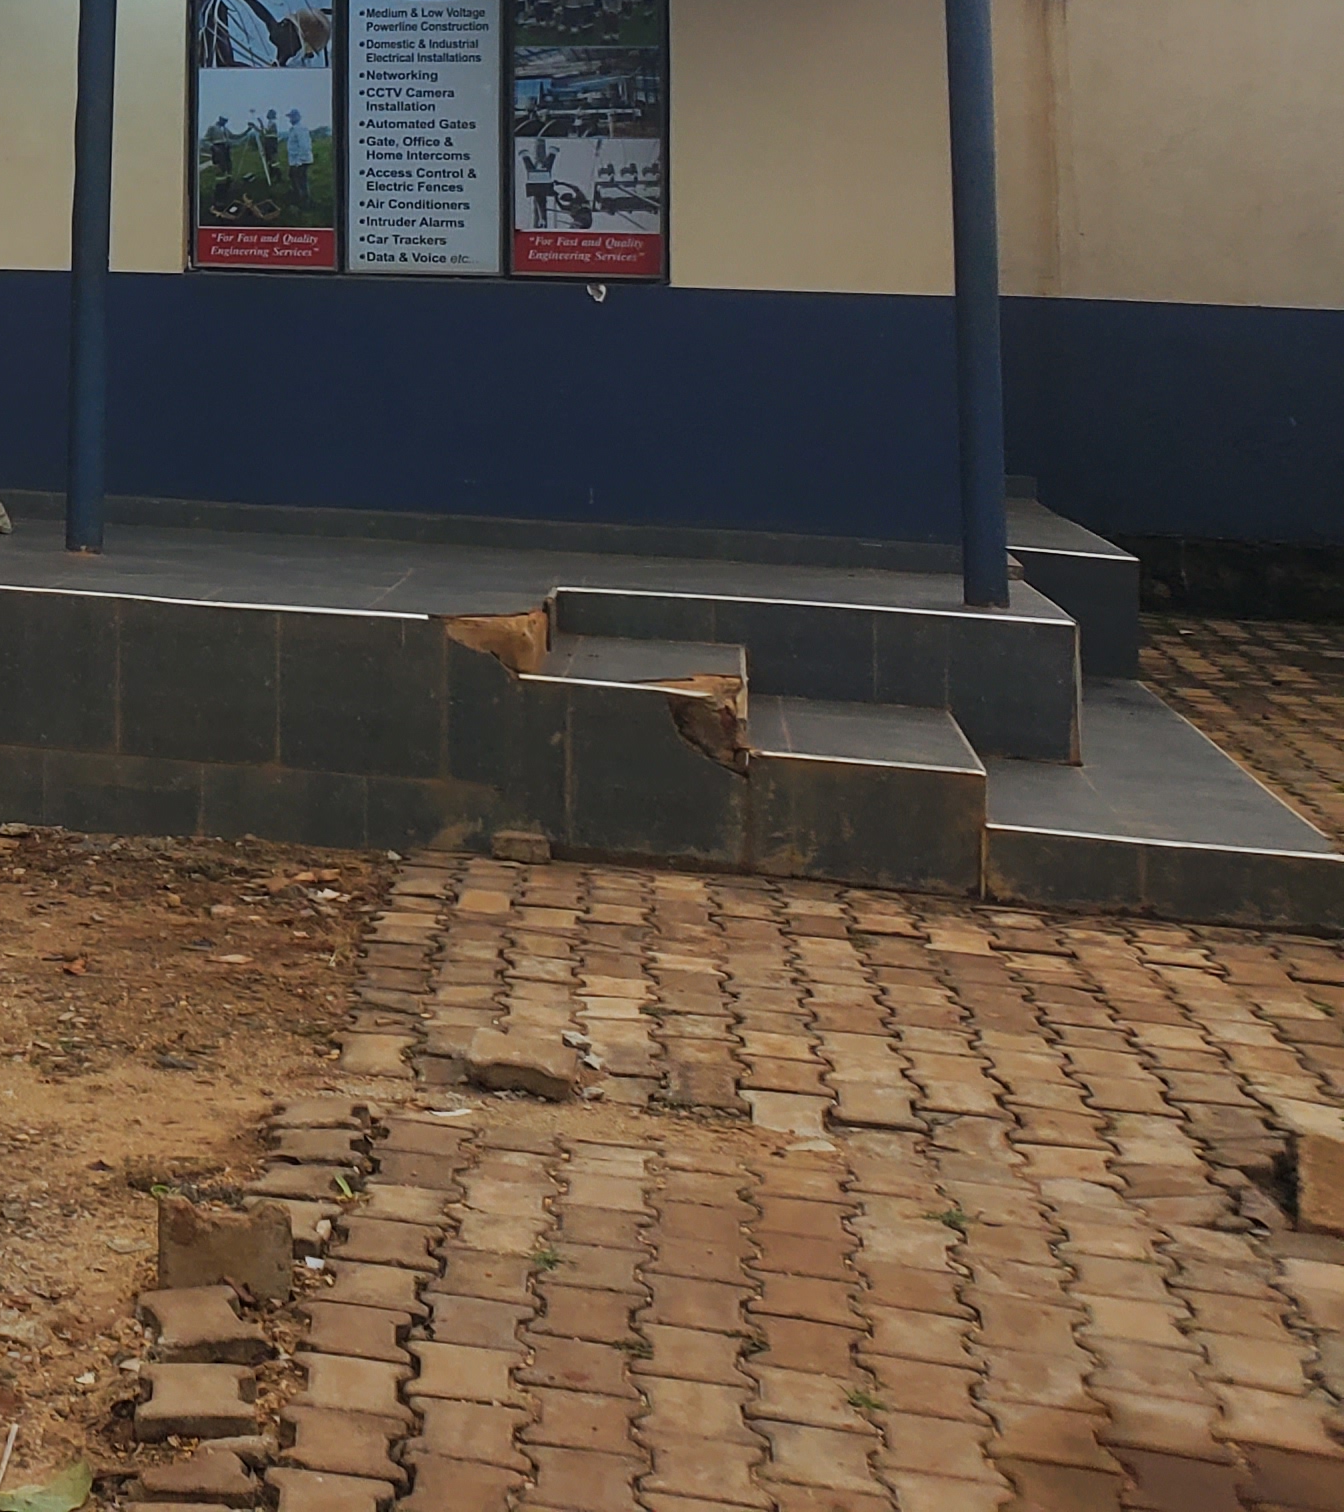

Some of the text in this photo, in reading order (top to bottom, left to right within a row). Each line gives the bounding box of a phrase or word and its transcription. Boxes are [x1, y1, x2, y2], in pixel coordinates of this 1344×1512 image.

[366, 8, 485, 19] Medium & Low Voltage
[366, 22, 489, 32] Powerline Construction
[366, 39, 478, 49] Domestic & Industrial
[366, 53, 482, 62] Electrical Installations
[366, 70, 438, 82] Networking
[366, 88, 454, 98] CCTV Camera
[366, 102, 436, 111] Installation
[366, 119, 476, 129] Automated Gates
[366, 137, 453, 148] Gate, Office &
[366, 151, 471, 161] Home Intercoms
[366, 168, 477, 179] Access Control &
[366, 181, 464, 192] Electric Fences
[366, 199, 470, 210] Air Conditioners
[366, 217, 464, 228] Intruder Alarms
[237, 233, 258, 242] Fast
[260, 233, 279, 243] and
[283, 234, 318, 245] Quality
[366, 234, 447, 245] Car Trackers
[211, 246, 269, 257] Engineering
[366, 252, 394, 262] Data
[399, 253, 408, 262] &
[412, 253, 446, 263] Voice
